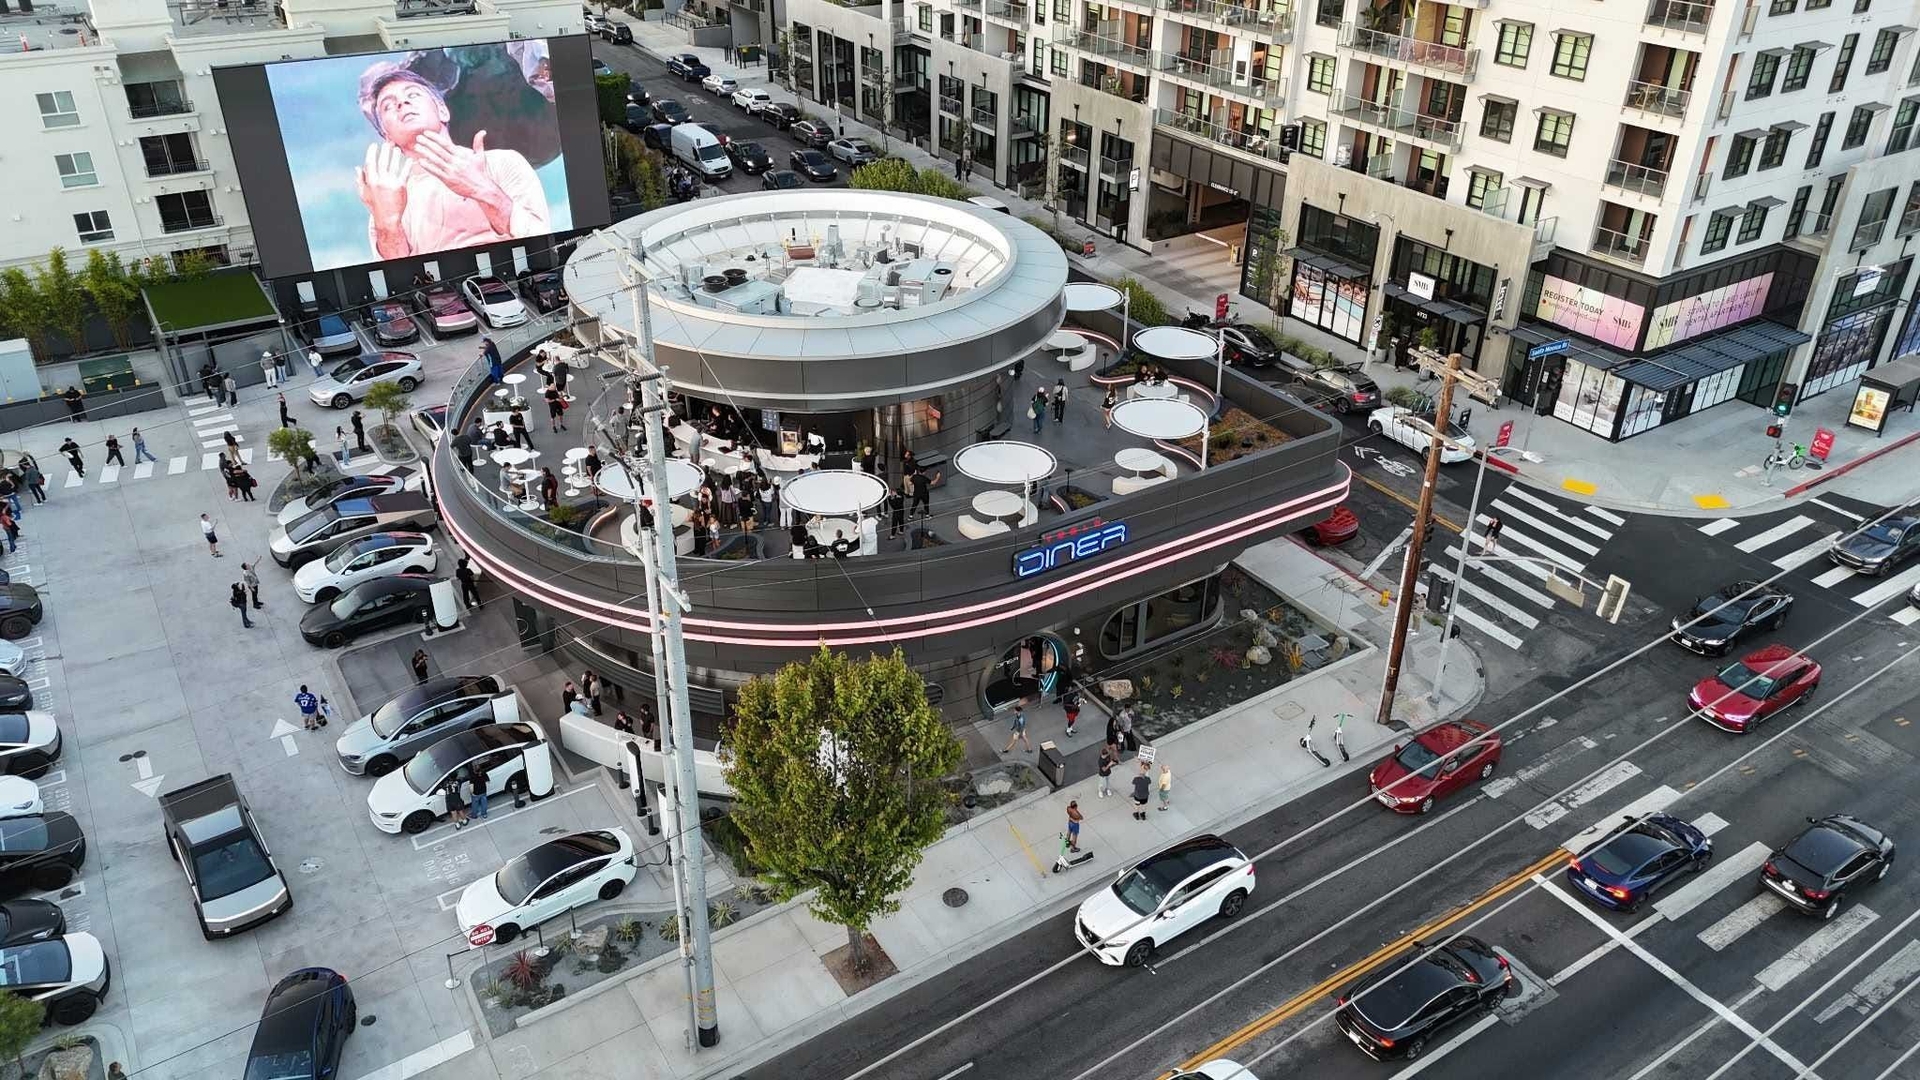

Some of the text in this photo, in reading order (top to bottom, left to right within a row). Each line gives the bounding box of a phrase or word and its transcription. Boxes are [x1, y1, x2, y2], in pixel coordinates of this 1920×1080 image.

[1413, 280, 1428, 290] SMB
[1544, 290, 1604, 316] REGISTER TODAY
[1612, 315, 1631, 329] SMB
[1018, 524, 1126, 576] DINER
[475, 936, 490, 944] ENTER
